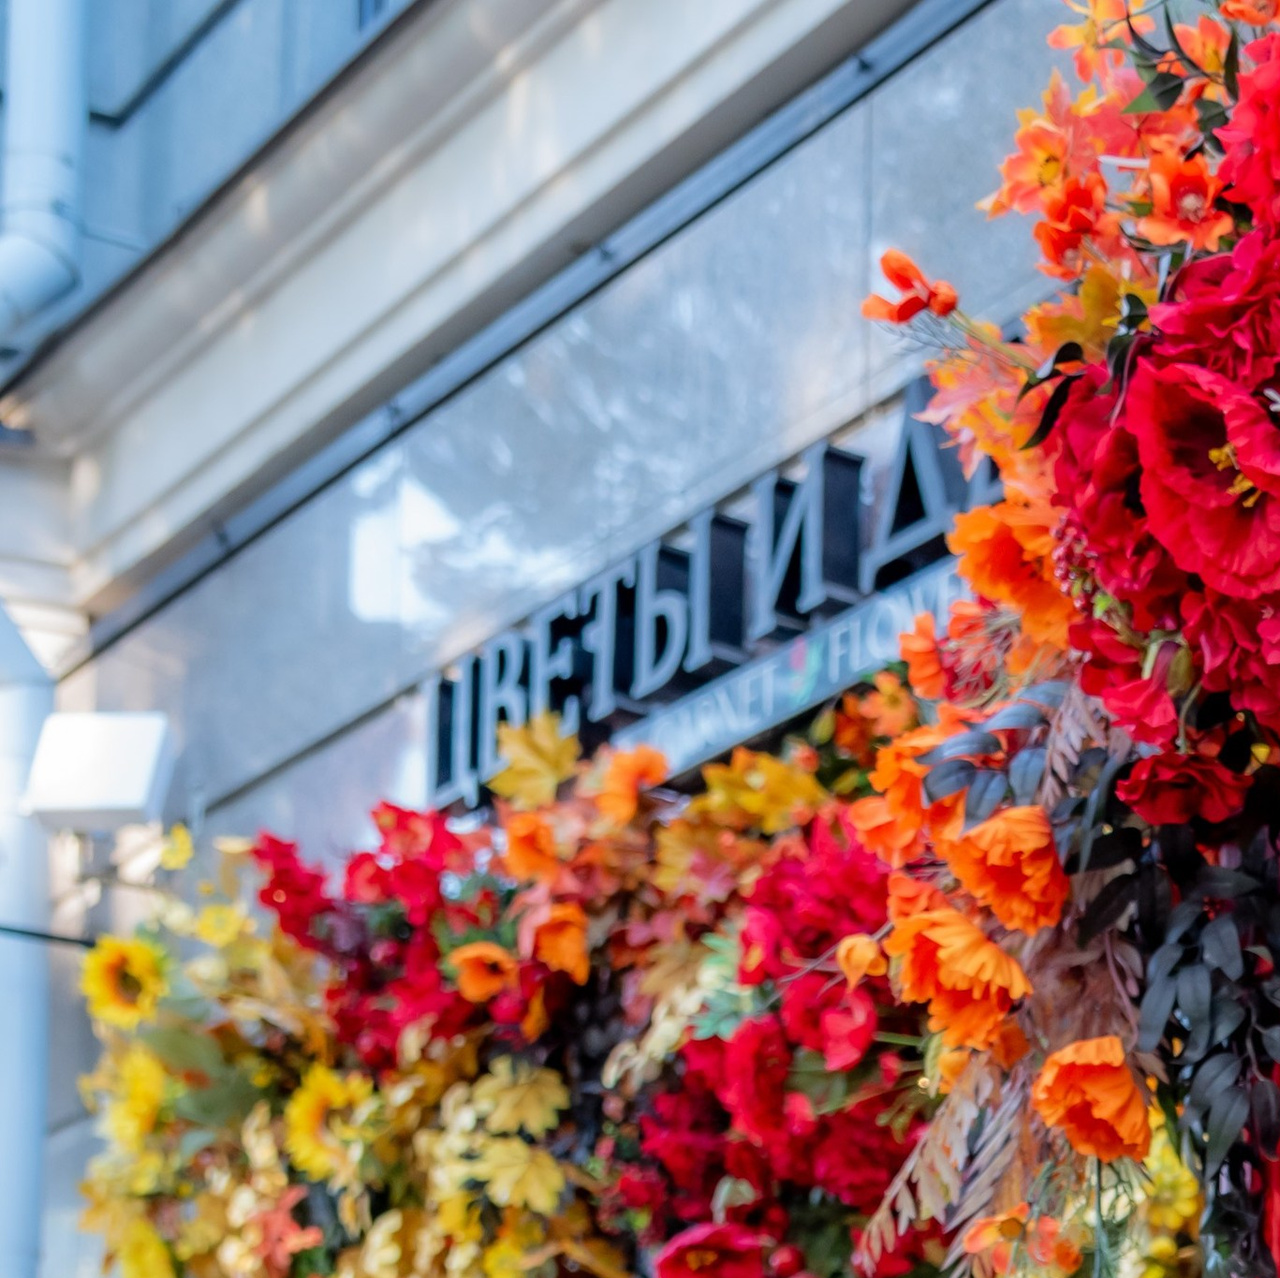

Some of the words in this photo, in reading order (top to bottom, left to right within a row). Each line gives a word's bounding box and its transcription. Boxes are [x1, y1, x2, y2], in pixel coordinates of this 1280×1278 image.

[423, 507, 713, 809] ЦВЕТЫ
[744, 442, 828, 642] И
[857, 372, 1005, 596] Д
